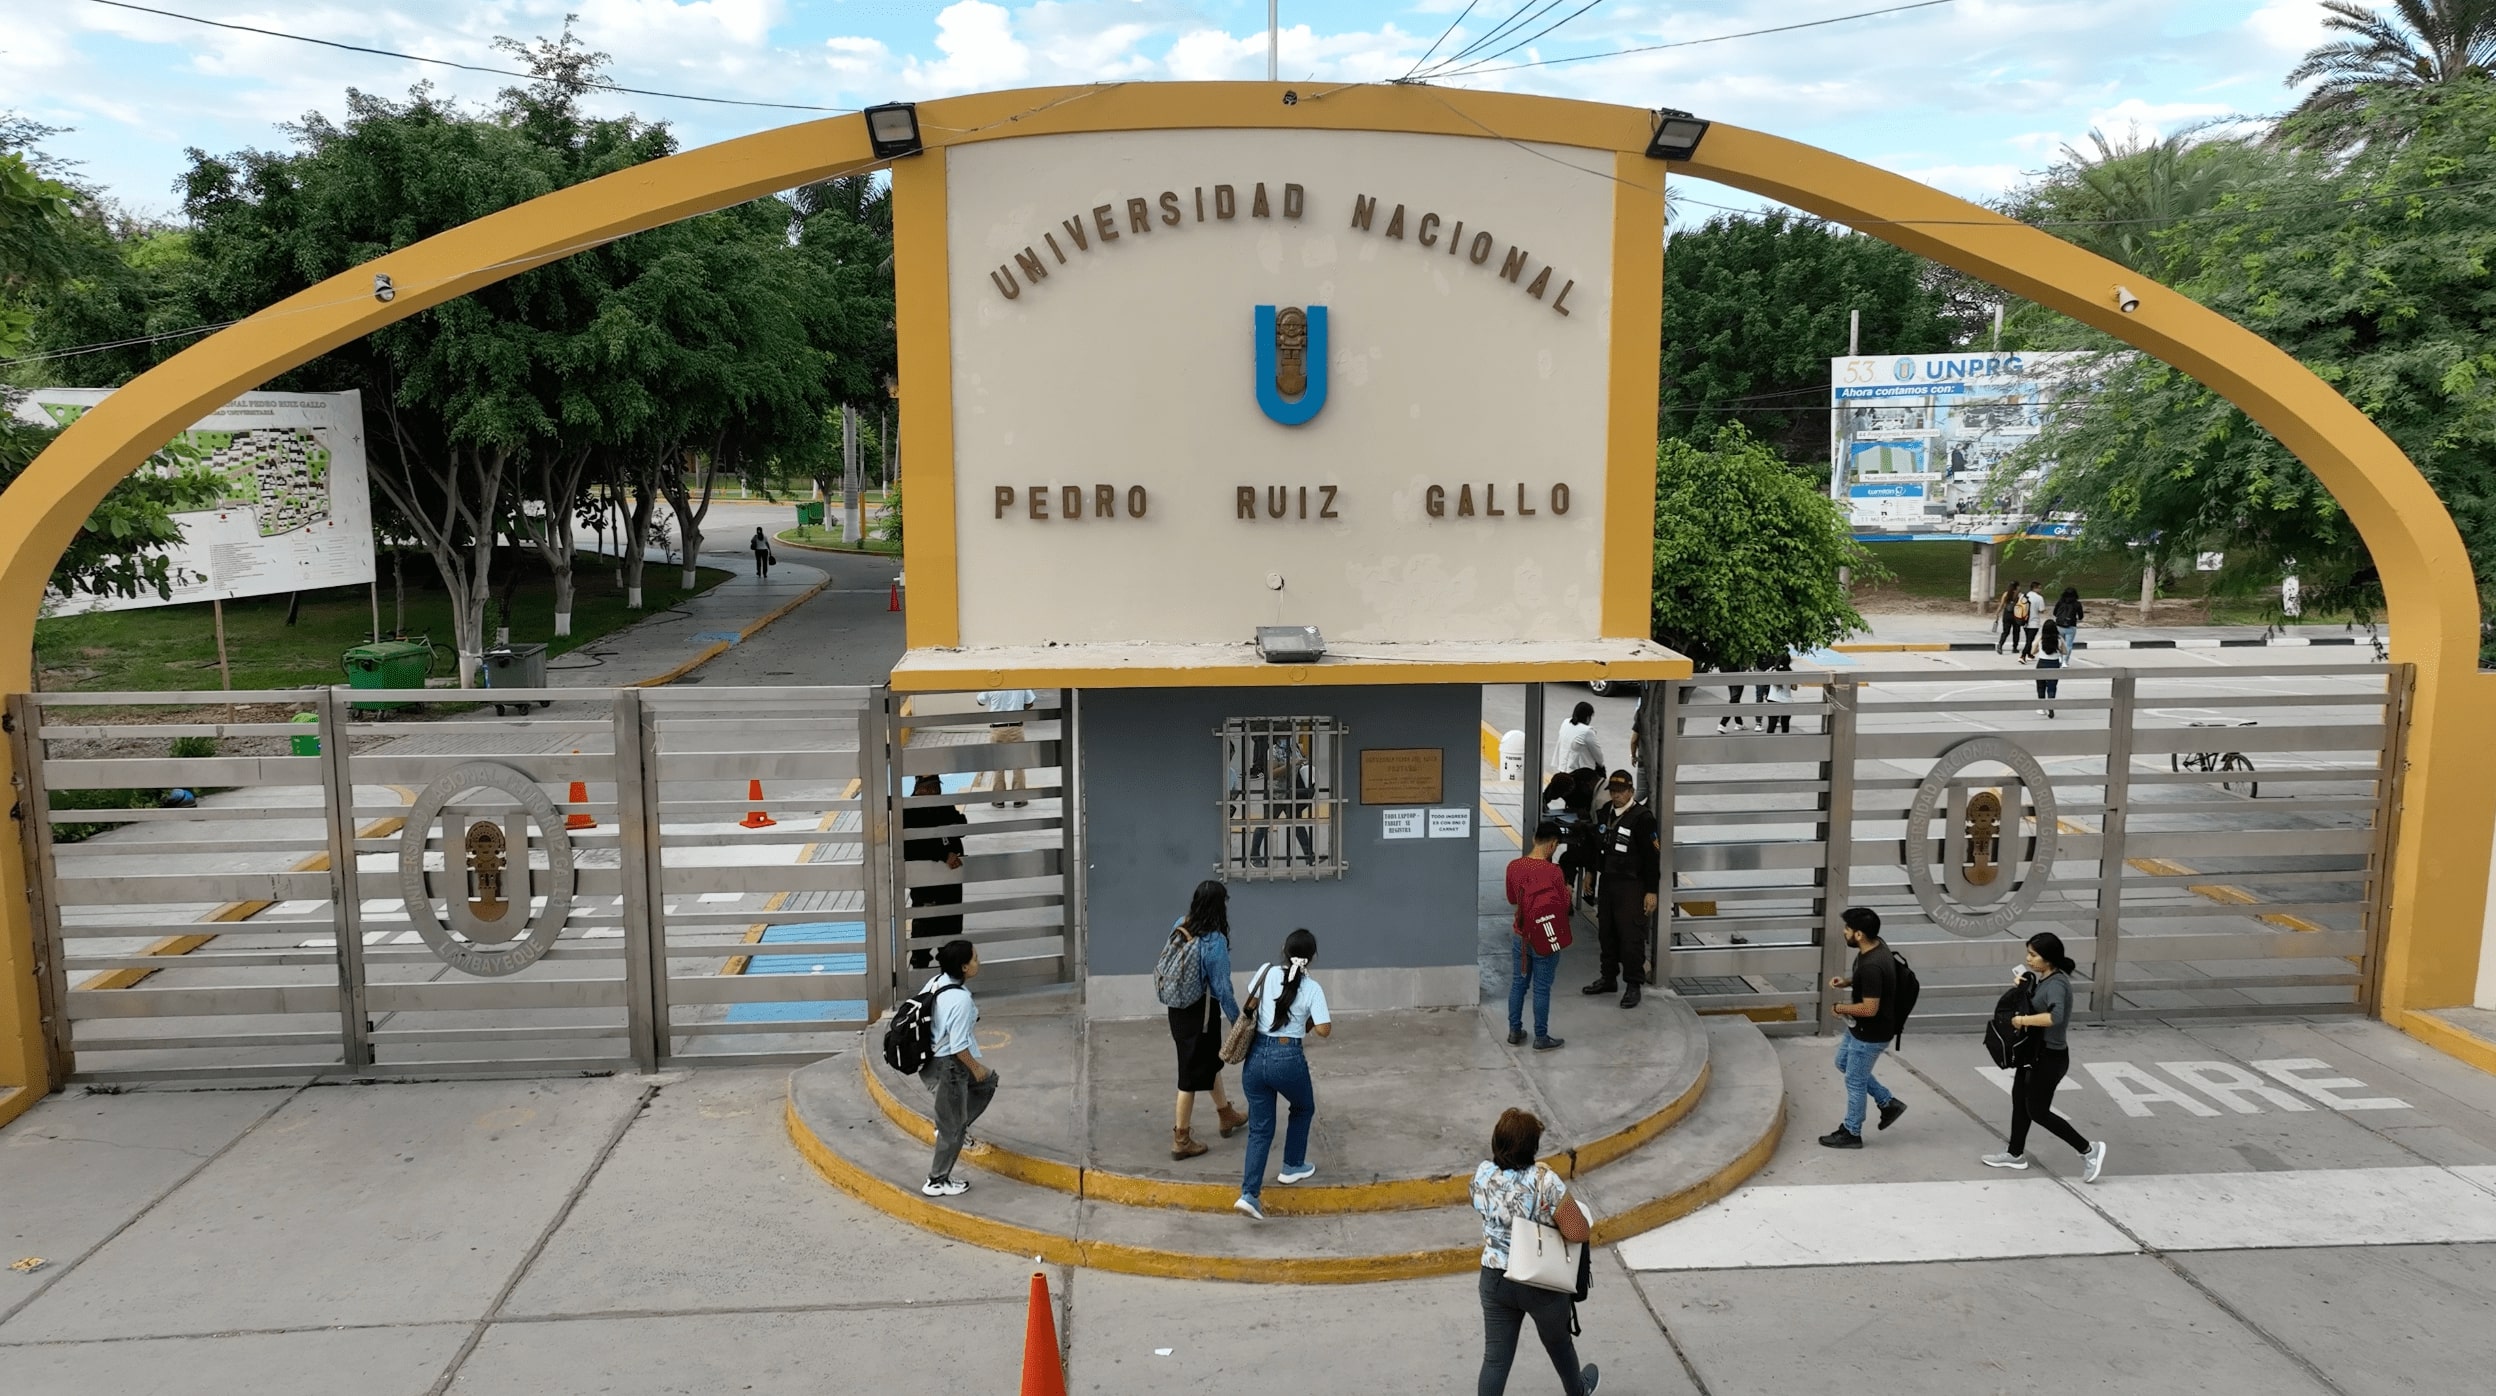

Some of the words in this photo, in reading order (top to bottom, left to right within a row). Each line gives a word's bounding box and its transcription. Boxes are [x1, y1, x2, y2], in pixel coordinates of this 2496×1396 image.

[991, 183, 1304, 299] UNIVERSIDAD
[1352, 194, 1575, 316] NACIONAL
[1844, 361, 1876, 383] 53
[1926, 356, 2023, 379] UNPRG
[1842, 388, 1872, 397] Ahora
[1875, 385, 1928, 395] contamos
[1930, 385, 1955, 394] con:
[995, 484, 1148, 519] PEDRO
[1237, 485, 1339, 519] RUIZ
[1426, 483, 1570, 516] GALLO
[1933, 744, 2001, 782] NACIONAL
[2007, 749, 2043, 787] PEDRO
[2036, 787, 2052, 821] RUIZ
[1910, 783, 1937, 877] UNIVERSIDAD
[2035, 827, 2053, 874] GALLO
[1535, 914, 1556, 924] adidas
[1932, 902, 2023, 931] LAMBAYEQUE
